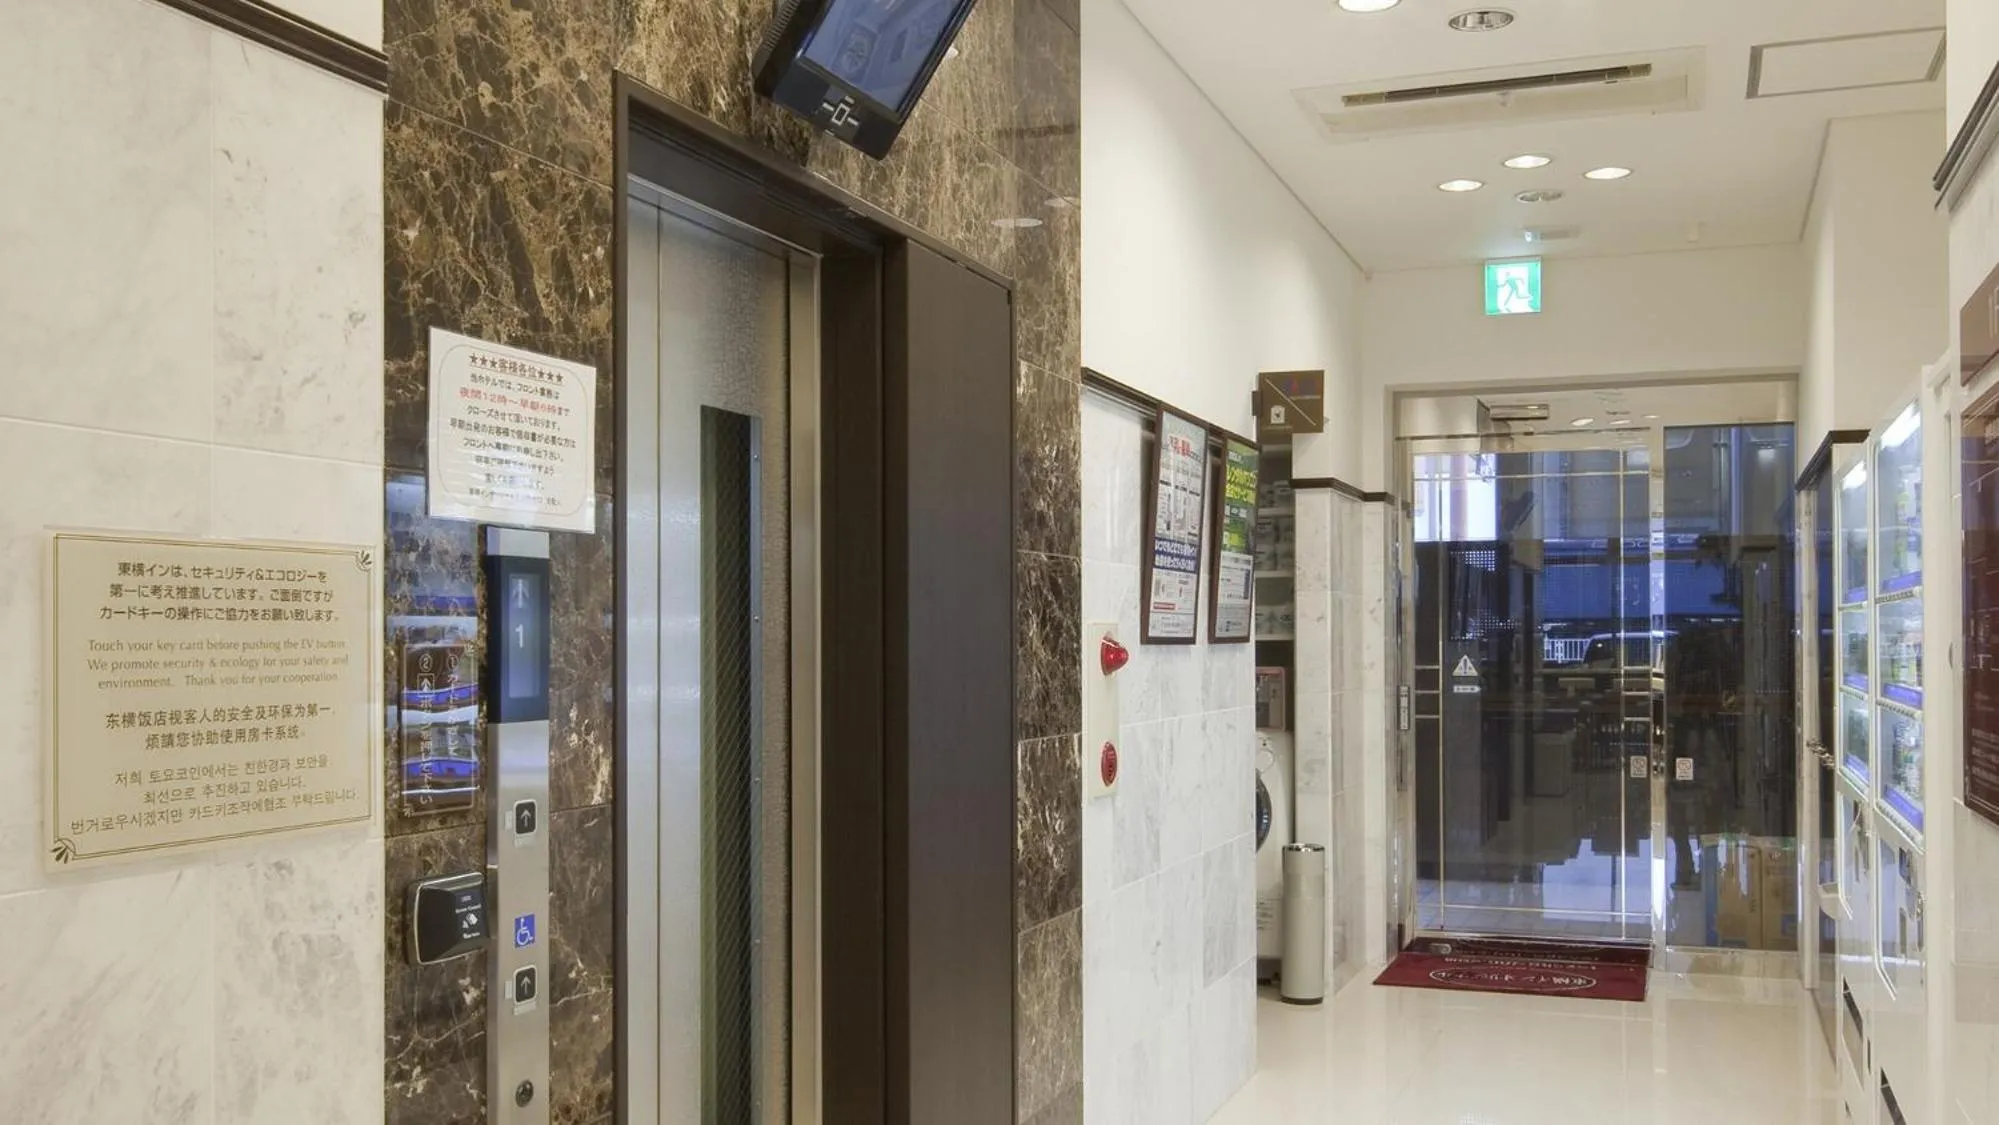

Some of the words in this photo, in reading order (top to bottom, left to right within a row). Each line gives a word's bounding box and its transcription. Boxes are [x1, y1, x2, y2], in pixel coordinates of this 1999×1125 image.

[515, 623, 524, 649] 1
[89, 639, 124, 652] Touch
[87, 658, 107, 671] We
[111, 659, 160, 673] promote
[185, 674, 217, 687] Thank
